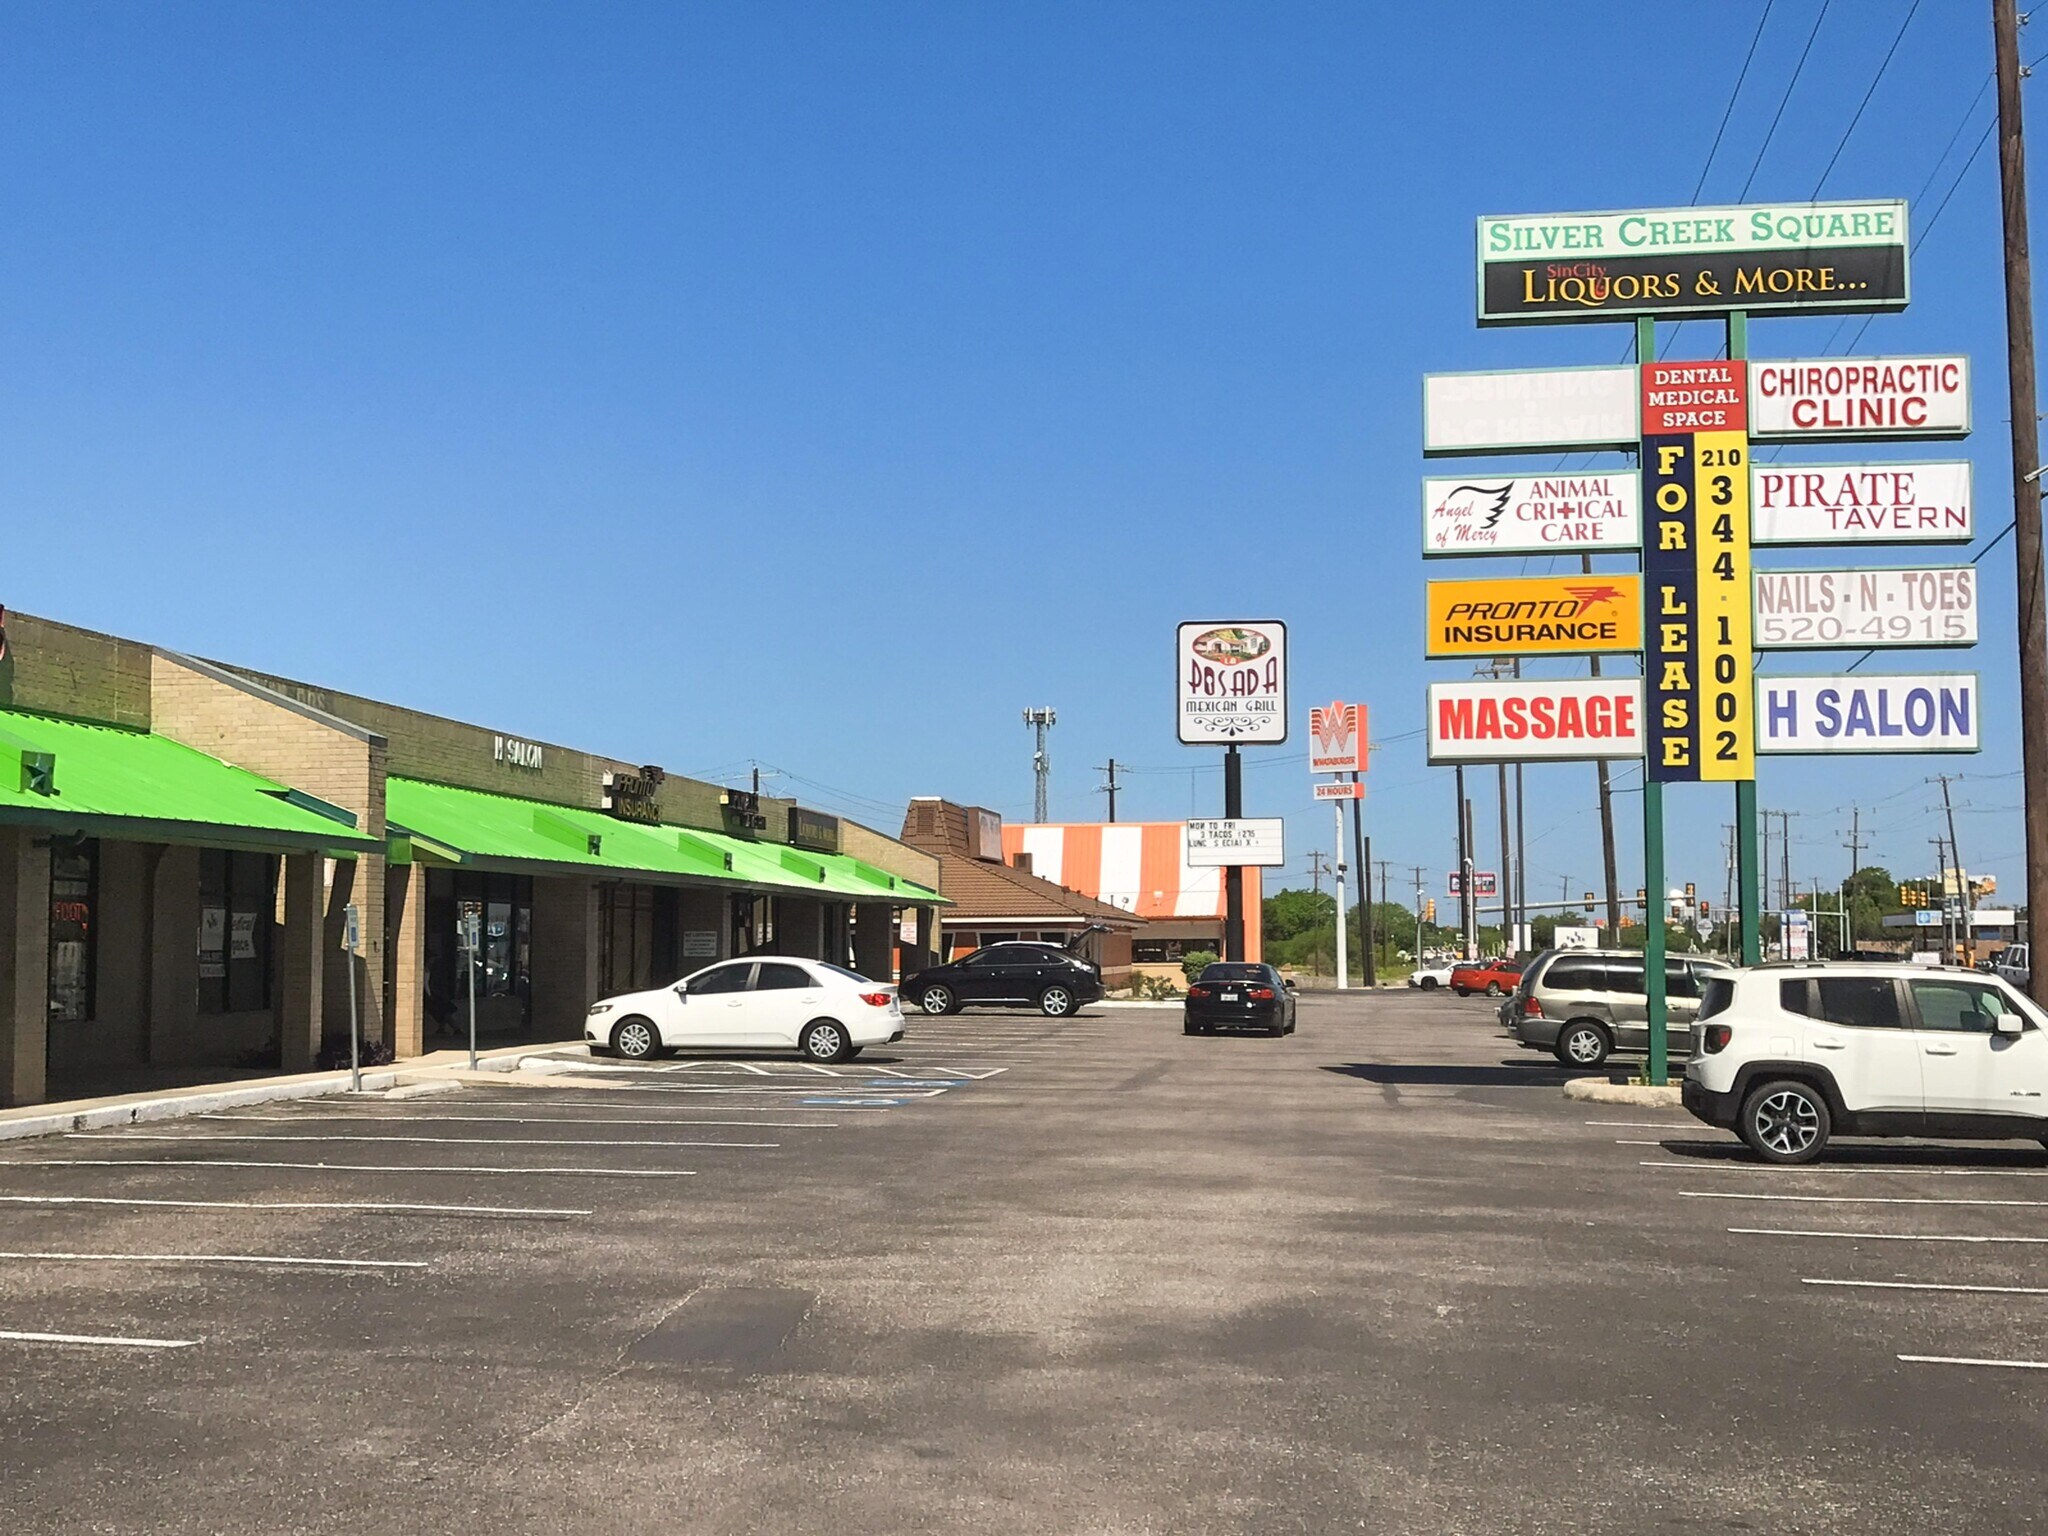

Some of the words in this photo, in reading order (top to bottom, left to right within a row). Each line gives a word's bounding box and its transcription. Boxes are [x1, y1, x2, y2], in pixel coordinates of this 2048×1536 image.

[1490, 223, 1604, 252] SILVER
[1619, 217, 1735, 247] CREEK
[1751, 211, 1894, 242] SQUARE
[1522, 269, 1681, 307] LIQUORS
[1695, 270, 1722, 296] &
[1733, 266, 1867, 295] MORE...
[1654, 368, 1732, 385] DENTAL
[1760, 363, 1959, 397] CHIROPRACTIC
[1648, 388, 1740, 407] MEDICAL
[1663, 410, 1726, 427] SPACE
[1792, 396, 1928, 428] CLINIC
[1701, 448, 1741, 467] 210
[1529, 478, 1614, 500] ANIMAL
[1656, 446, 1688, 550] FOR
[1760, 472, 1916, 508] PIRATE
[1432, 500, 1474, 523] Angel
[1824, 506, 1966, 530] TAVERN
[1435, 529, 1450, 548] of
[1454, 524, 1498, 545] Mercy
[1541, 522, 1603, 542] CARE
[1758, 574, 1836, 614] NAILS
[1860, 574, 1878, 612] N
[1902, 571, 1972, 611] TOES
[1446, 600, 1580, 621] PRONTO
[1444, 622, 1617, 643] INSURANCE
[1763, 614, 1967, 642] 520-4915
[1187, 656, 1278, 697] POSADA
[1659, 586, 1691, 767] LEASE
[1186, 700, 1238, 712] MEXICAN
[1245, 700, 1277, 712] GRILL
[1439, 695, 1635, 740] MASSAGE
[1768, 690, 1798, 738] H
[1815, 688, 1971, 738] SALON
[507, 738, 543, 769] SALON
[1316, 787, 1326, 796] 24
[1327, 786, 1353, 795] HOURS
[1209, 830, 1232, 838] TACOS
[1224, 821, 1236, 829] FRI
